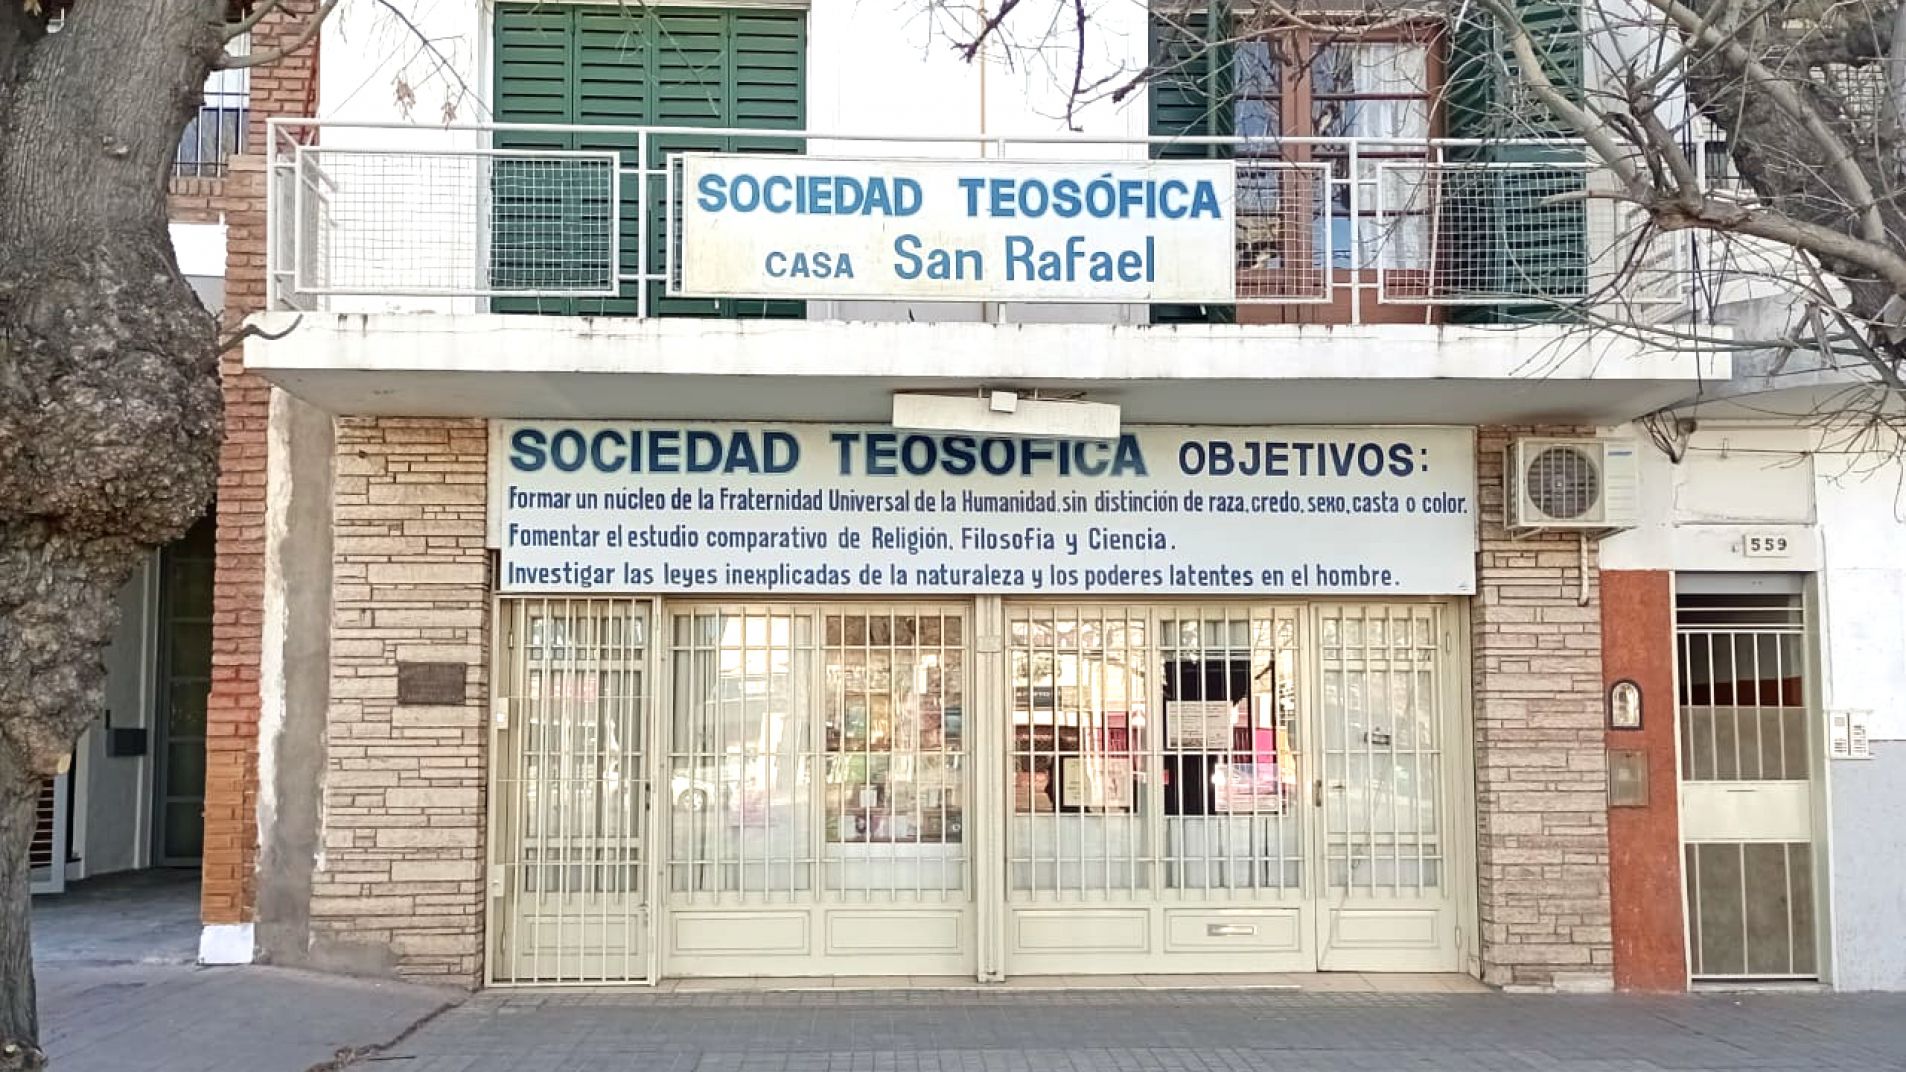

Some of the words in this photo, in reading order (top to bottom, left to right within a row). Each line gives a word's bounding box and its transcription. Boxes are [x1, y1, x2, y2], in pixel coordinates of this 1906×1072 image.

[697, 174, 923, 217] SOCIEDAD
[958, 173, 1222, 219] TEOSÓFICA
[764, 251, 854, 279] CASA
[893, 234, 984, 281] San
[1004, 235, 1155, 282] Rafael
[509, 427, 801, 475] SOCIEDAD
[1178, 440, 1430, 477] OBJETIVOS:
[508, 485, 571, 509] Formar
[576, 492, 598, 509] un
[604, 487, 665, 510] núcleo
[671, 487, 692, 510] de
[698, 487, 714, 510] la
[720, 487, 823, 511] Fraternidad
[828, 489, 909, 512] Universal
[915, 489, 936, 512] de
[941, 489, 956, 512] la
[1095, 489, 1178, 513] distinción
[1183, 490, 1204, 512] de
[1352, 491, 1399, 513] casta
[1406, 496, 1416, 513] o
[1422, 491, 1468, 514] color.
[508, 523, 600, 547] Fomentar
[607, 524, 622, 547] el
[628, 524, 699, 548] estudio
[706, 526, 827, 552] comparativo
[838, 526, 860, 548] de
[1065, 533, 1078, 555] y
[1089, 527, 1176, 550] Ciencia.
[1750, 538, 1787, 552] 559
[508, 561, 615, 587] Investigar
[624, 562, 654, 584] las
[664, 562, 717, 588] leyes
[726, 563, 851, 590] inexplicadas
[859, 563, 882, 586] de
[890, 563, 908, 586] la
[916, 563, 1024, 586] naturaleza
[1031, 569, 1042, 589] y
[1050, 564, 1079, 586] los
[1085, 564, 1162, 591] poderes
[1169, 564, 1253, 587] latentes
[1261, 569, 1284, 587] en
[1291, 564, 1308, 587] el
[1316, 564, 1400, 587] hombre.
